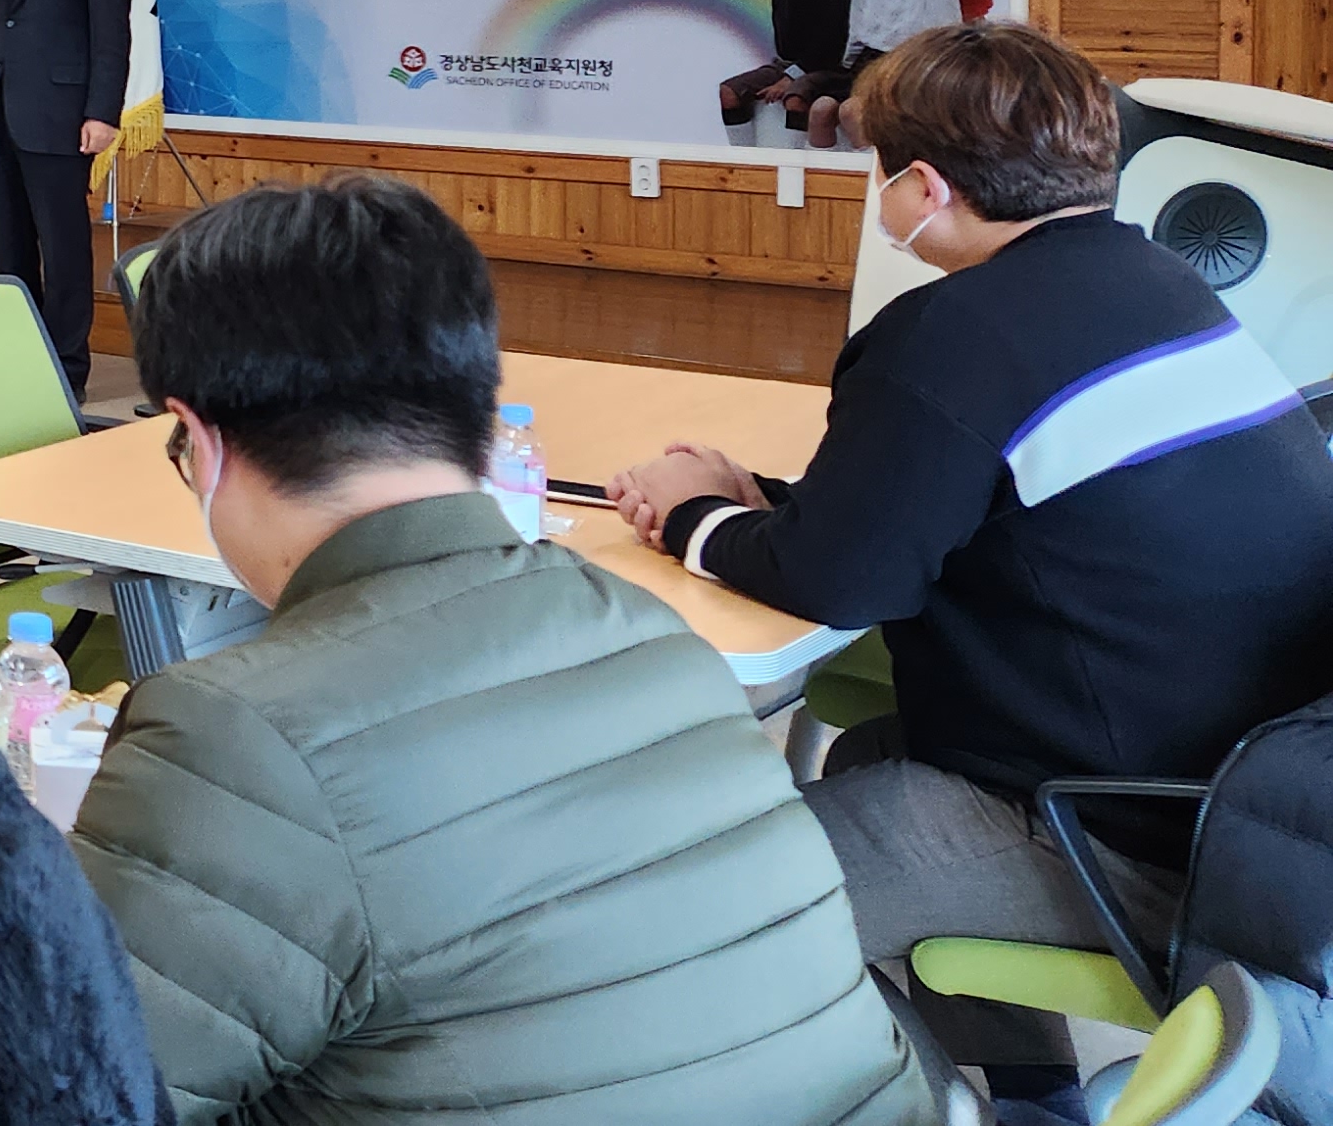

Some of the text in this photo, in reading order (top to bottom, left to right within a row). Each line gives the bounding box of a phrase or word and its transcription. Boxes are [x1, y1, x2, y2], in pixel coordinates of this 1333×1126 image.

[439, 54, 614, 78] 경상남도사천교육지원청
[446, 75, 610, 92] SACHEON OFFICE OF EDUCATION
